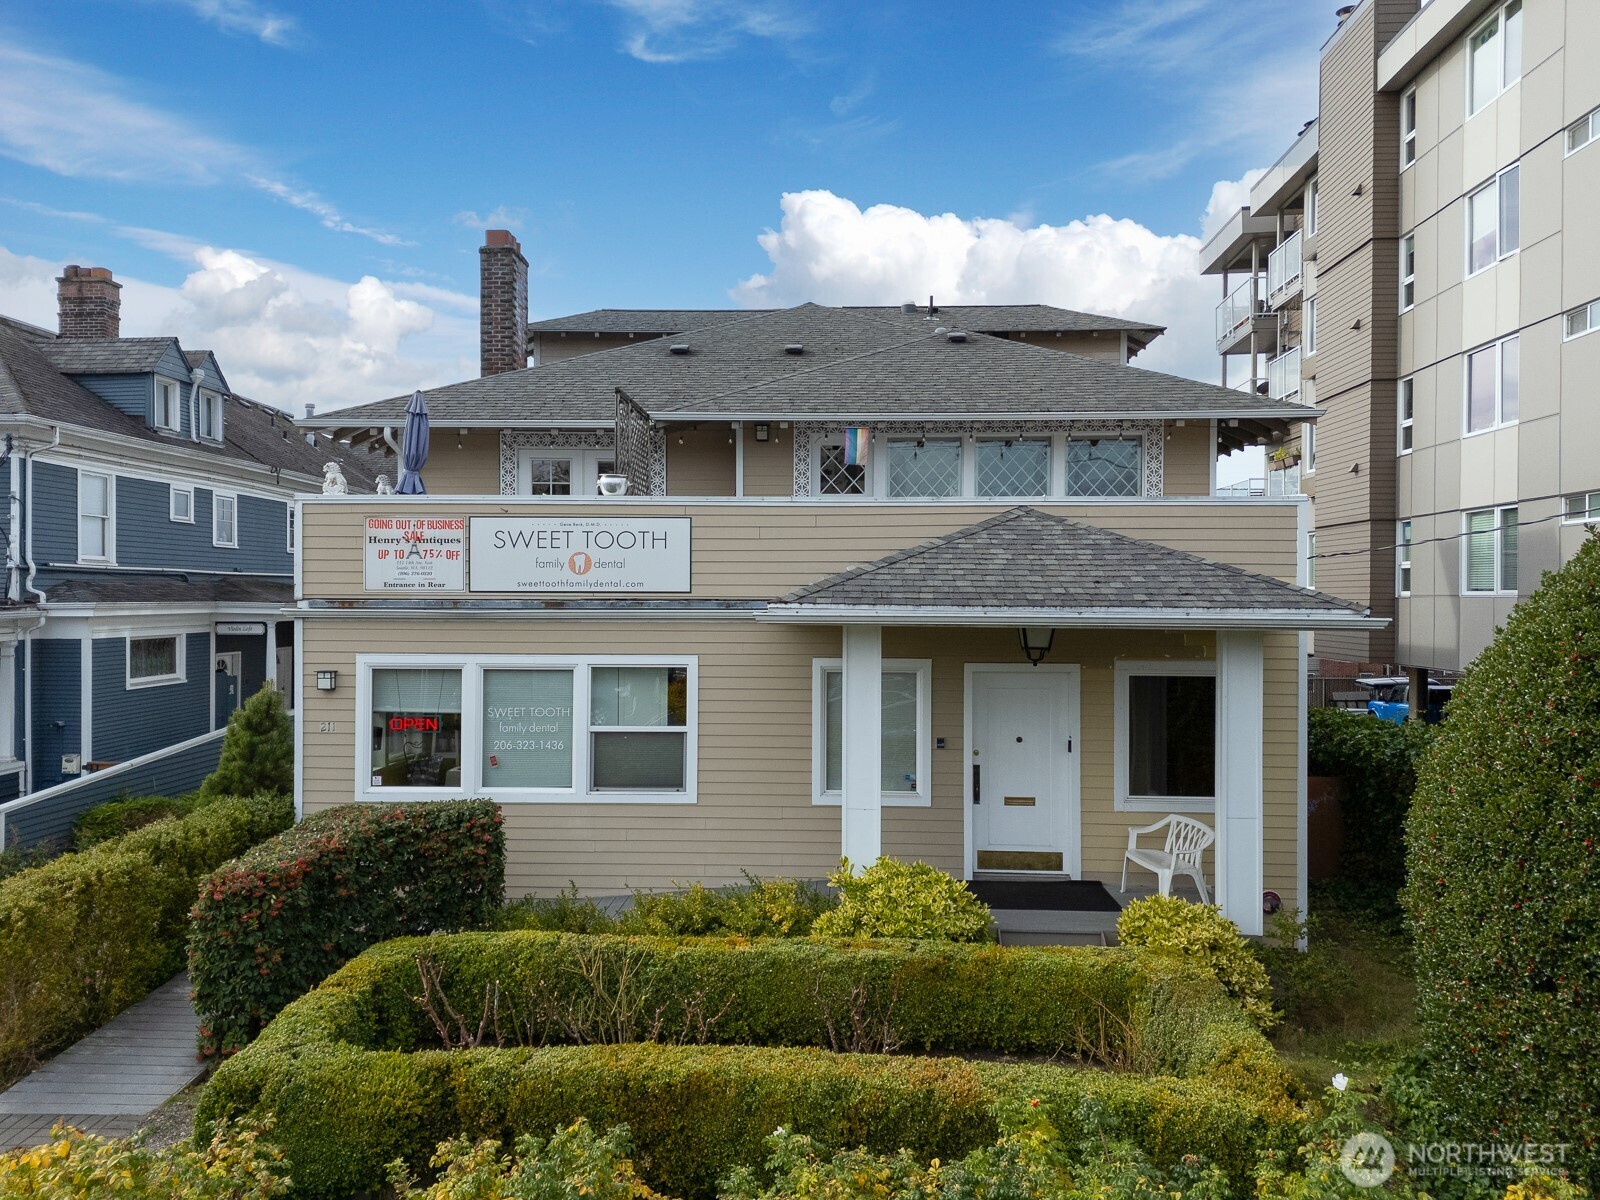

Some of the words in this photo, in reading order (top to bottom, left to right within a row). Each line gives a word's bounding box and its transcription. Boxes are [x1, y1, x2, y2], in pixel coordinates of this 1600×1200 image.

[368, 519, 393, 529] GOING
[396, 519, 412, 530] OUT
[416, 519, 426, 530] OF
[427, 519, 464, 530] BUSINESS
[404, 530, 424, 542] SALE
[414, 536, 461, 546] Antiques
[493, 530, 574, 549] SWEET
[582, 530, 667, 549] TOOTH
[378, 549, 389, 560] UP
[394, 549, 405, 560] TO
[423, 549, 443, 559] 75%
[446, 549, 460, 560] OFF
[535, 557, 565, 570] family
[594, 558, 626, 569] dental
[517, 579, 644, 589] sweettoothfamilydental.com
[487, 707, 526, 718] SWEET
[530, 707, 570, 718] TOOTH
[320, 721, 336, 733] 211
[389, 717, 438, 731] OPEN
[499, 722, 527, 735] family
[528, 722, 558, 733] dental
[493, 740, 564, 750] 206-323-1436
